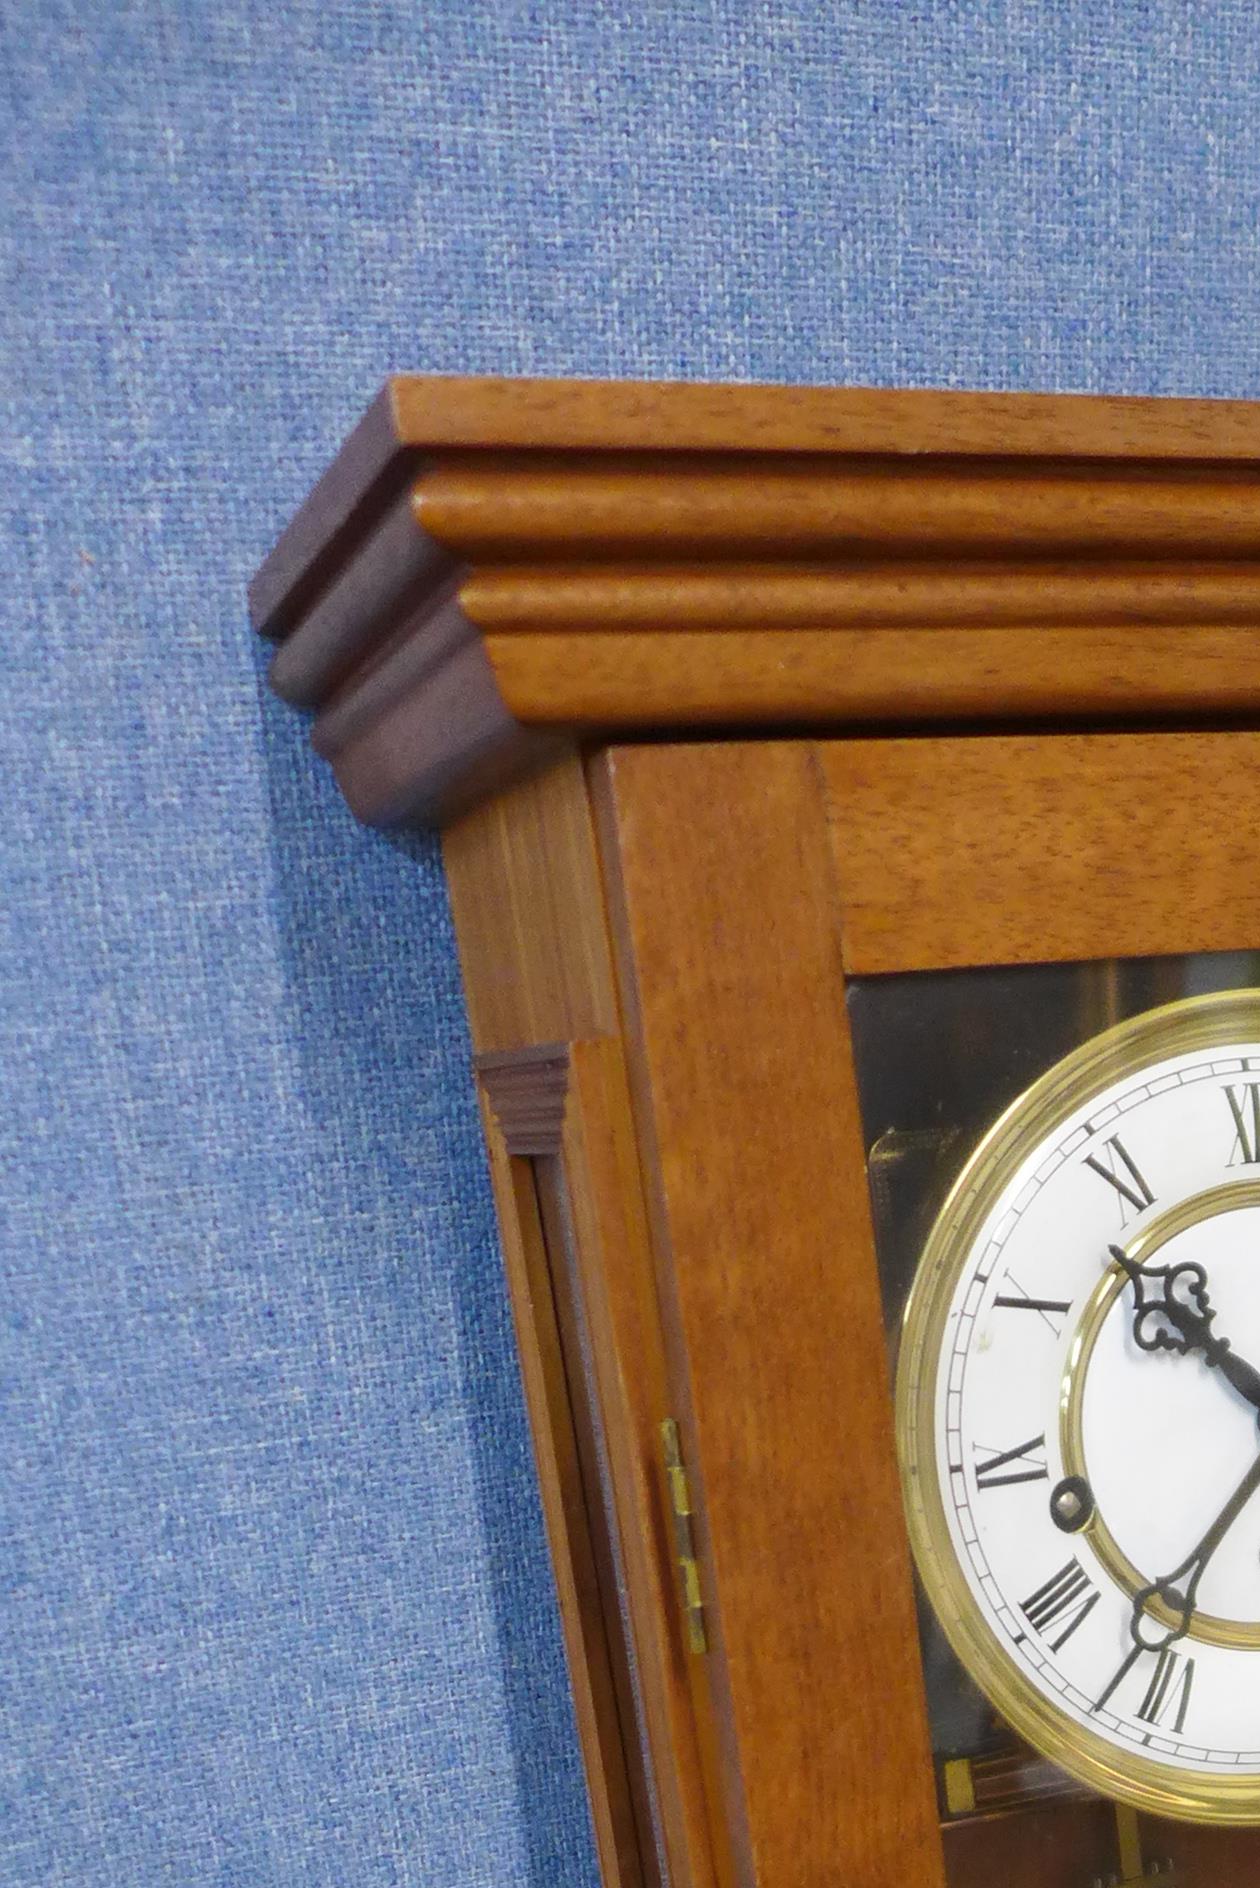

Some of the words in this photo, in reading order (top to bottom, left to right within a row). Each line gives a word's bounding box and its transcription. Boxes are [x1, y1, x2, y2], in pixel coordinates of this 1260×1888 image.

[1082, 1131, 1158, 1230] XI
[993, 1266, 1072, 1338] X
[972, 1432, 1049, 1493] IX
[1018, 1555, 1102, 1654] VIII
[1134, 1649, 1196, 1736] VII
